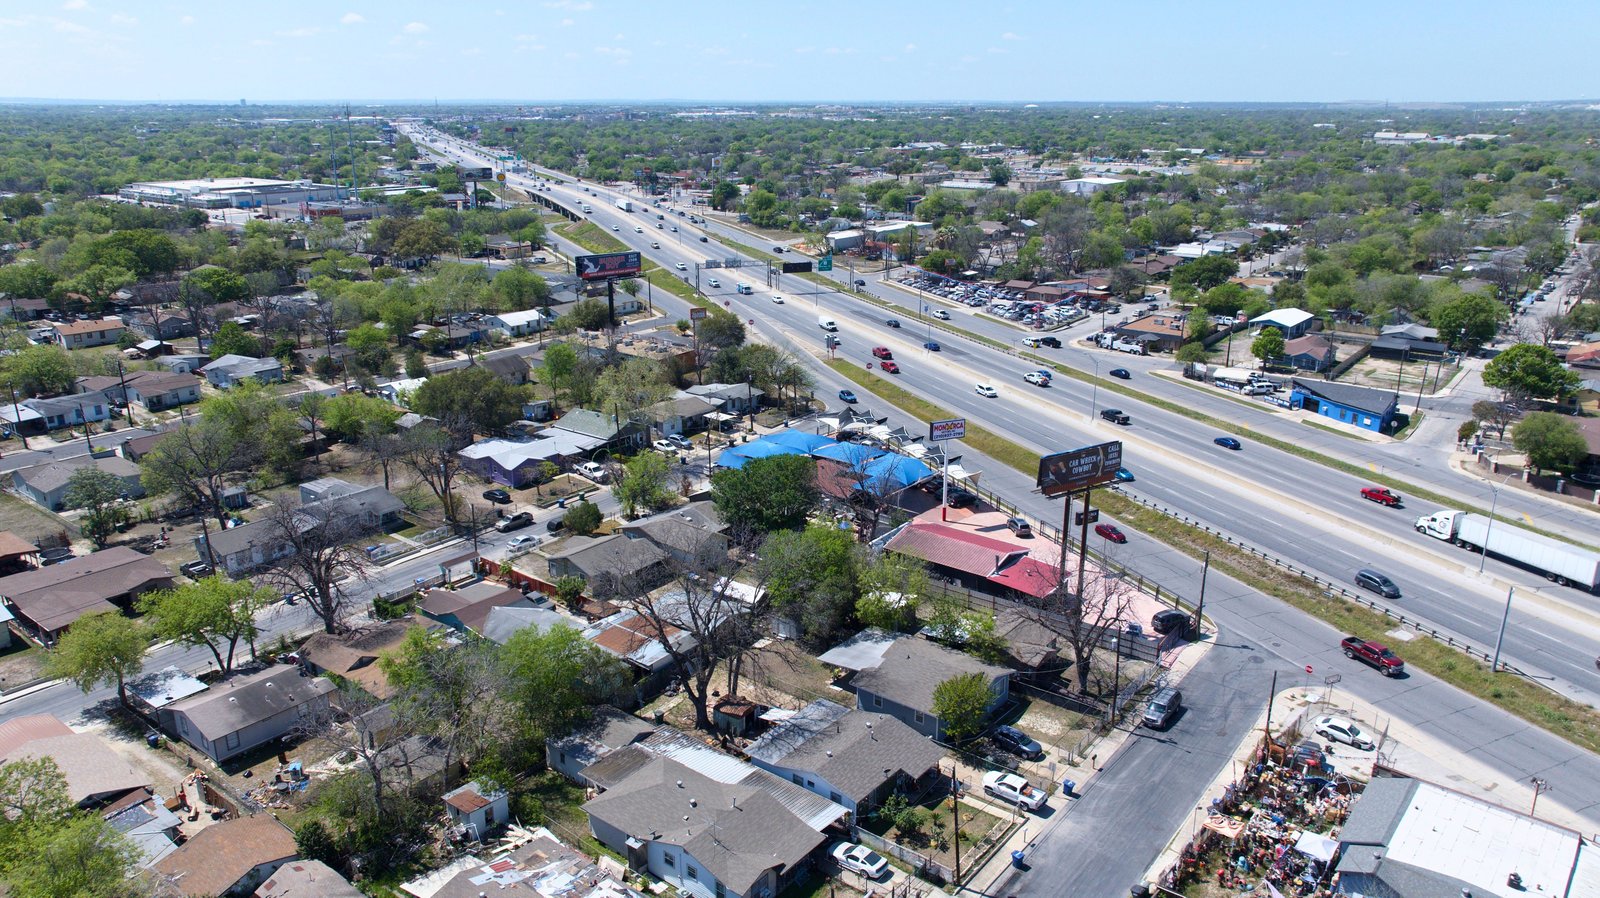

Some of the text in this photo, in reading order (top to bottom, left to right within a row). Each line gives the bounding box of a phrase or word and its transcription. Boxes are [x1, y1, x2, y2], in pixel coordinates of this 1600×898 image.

[1108, 444, 1120, 452] CALL
[1069, 456, 1096, 468] CAR WRECK
[1072, 464, 1092, 474] COWBOY
